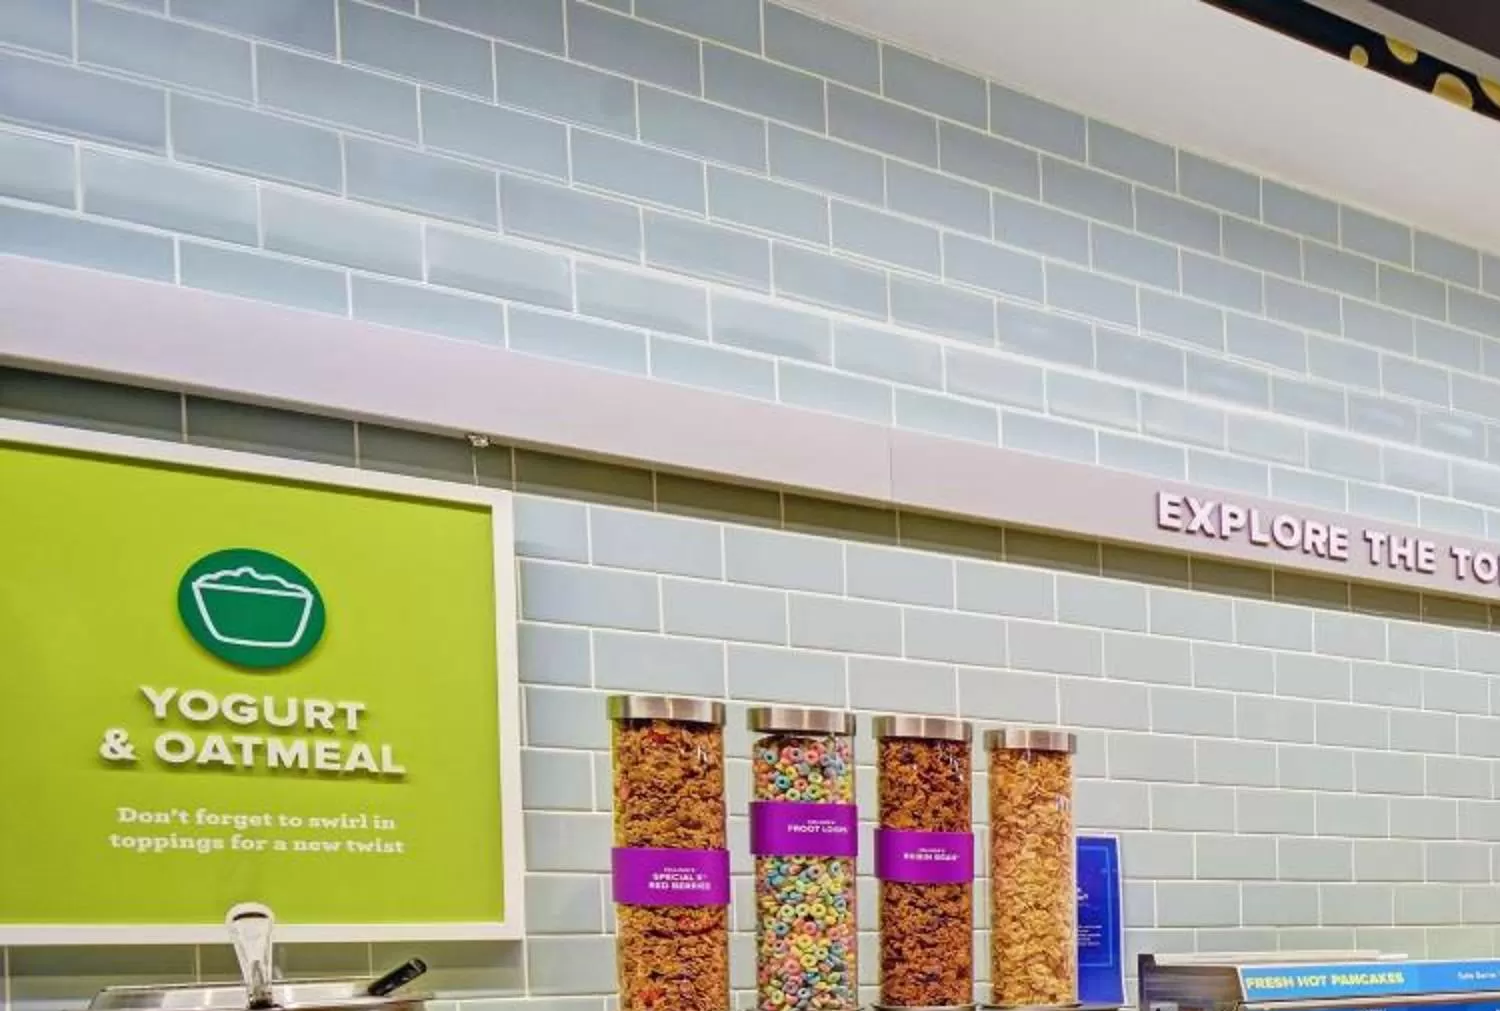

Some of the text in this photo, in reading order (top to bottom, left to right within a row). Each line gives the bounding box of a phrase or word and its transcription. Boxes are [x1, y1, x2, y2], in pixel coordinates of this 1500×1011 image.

[1156, 491, 1349, 561] EXPLORE
[1362, 529, 1436, 574] THE
[139, 686, 367, 732] YOGURT
[99, 727, 407, 775] & OATMEAL
[115, 806, 396, 830] Don't forget to swirl in
[109, 834, 405, 854] toppings for a new twist
[1246, 971, 1405, 989] FRESH HOT PANCAKES
